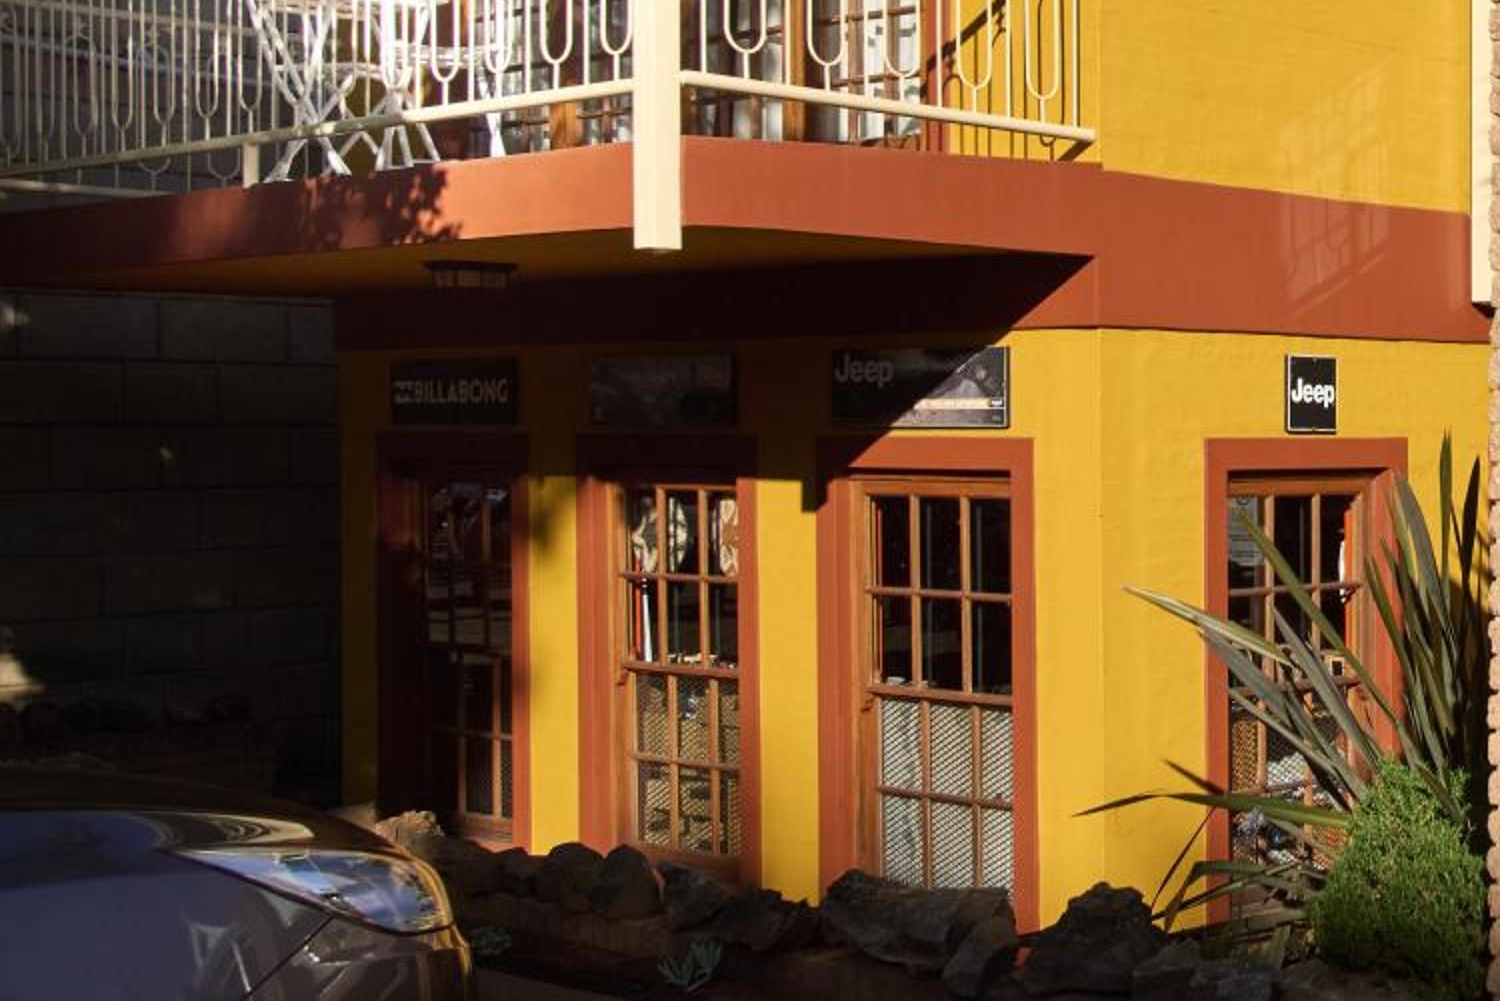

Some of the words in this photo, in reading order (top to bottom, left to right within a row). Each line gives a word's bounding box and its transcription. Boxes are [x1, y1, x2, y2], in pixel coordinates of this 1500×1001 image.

[833, 351, 896, 388] Jeep
[415, 378, 509, 405] BILLABONG
[1291, 377, 1335, 409] Jeep
